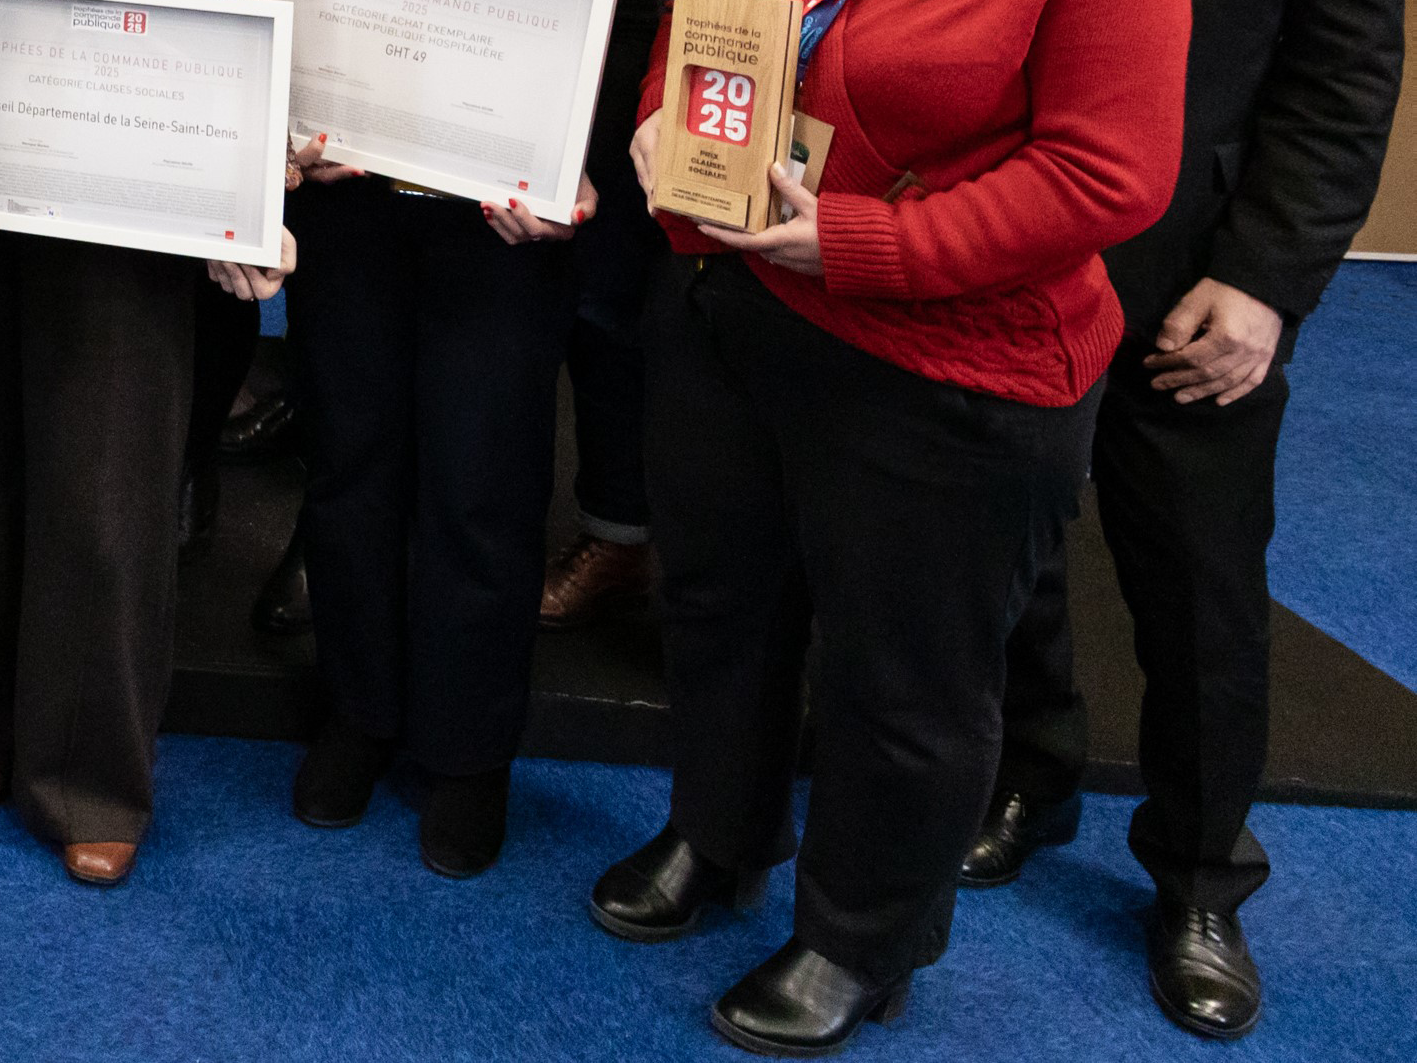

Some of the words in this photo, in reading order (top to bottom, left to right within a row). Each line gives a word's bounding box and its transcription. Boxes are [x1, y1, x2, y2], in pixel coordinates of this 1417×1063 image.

[73, 12, 122, 21] commande
[127, 13, 143, 23] 20
[402, 1, 428, 15] 2025
[487, 5, 560, 32] PUBLIQUE
[73, 18, 121, 30] publique
[127, 23, 142, 33] 25
[333, 2, 389, 23] CATÉGORIE
[390, 16, 424, 29] ACHAT
[427, 23, 494, 47] EXEMPLAIRE
[686, 17, 733, 33] trophées
[734, 24, 749, 35] de
[752, 29, 761, 38] la
[319, 11, 371, 30] FONCTION
[373, 23, 426, 43] PUBLIQUE
[428, 37, 505, 61] HOSPITALIÈRE
[685, 30, 760, 52] commande
[49, 47, 65, 58] DE
[72, 50, 87, 61] LA
[93, 52, 169, 71] COMMANDE
[175, 60, 243, 79] PUBLIQUE
[385, 43, 411, 58] GHT
[412, 50, 427, 63] 49
[683, 41, 759, 65] publique
[94, 65, 119, 78] 2025
[28, 74, 83, 89] CATÉGORIE
[86, 81, 132, 95] CLAUSES
[135, 87, 185, 101] SOCIALES
[702, 71, 752, 107] 20
[18, 102, 101, 123] Départemental
[103, 113, 117, 125] de
[120, 115, 131, 127] la
[134, 116, 238, 140] Seine-Saint-Denis
[698, 104, 748, 142] 25
[690, 157, 726, 171] CLAUSES
